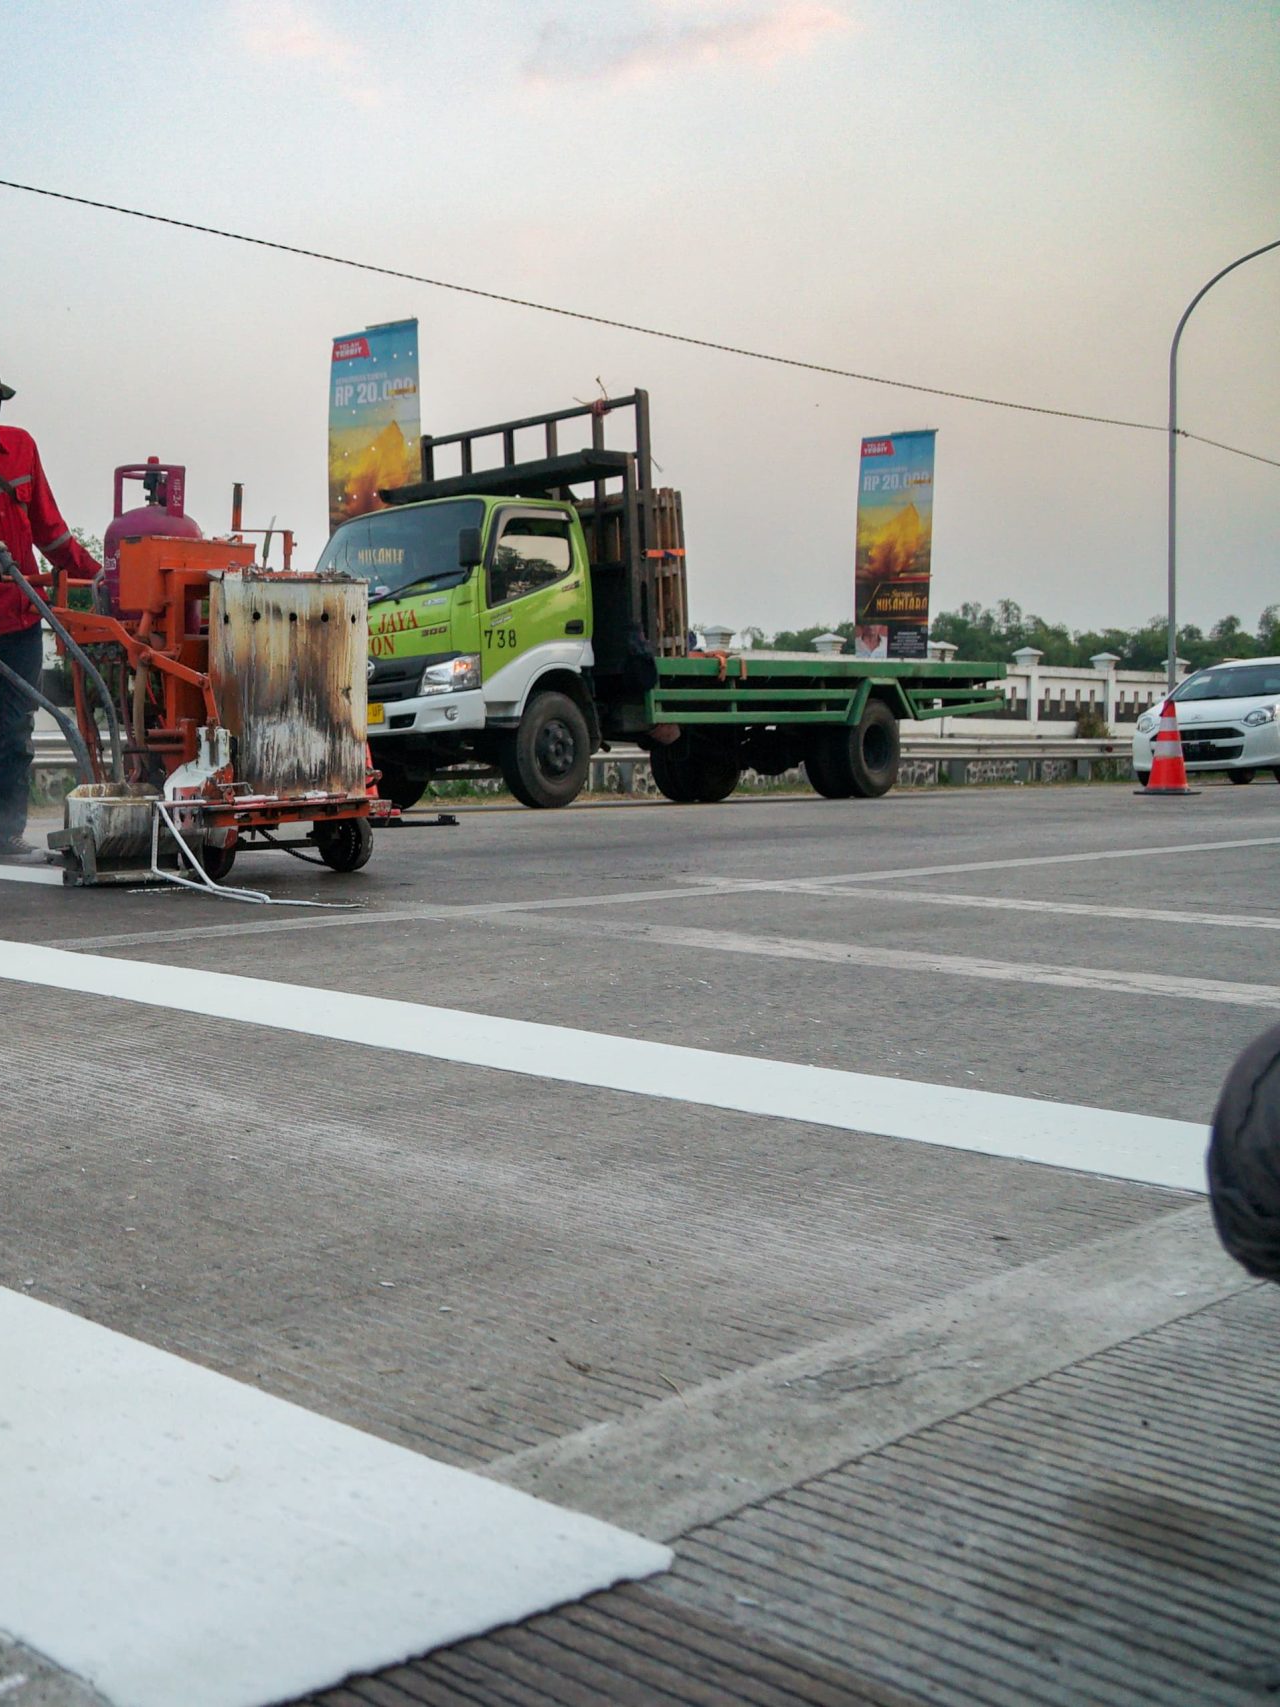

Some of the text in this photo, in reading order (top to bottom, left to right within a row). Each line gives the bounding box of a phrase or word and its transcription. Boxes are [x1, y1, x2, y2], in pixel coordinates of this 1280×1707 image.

[335, 385, 354, 407] RP
[864, 475, 880, 491] RP
[876, 596, 929, 612] NUSANTARA
[378, 609, 420, 634] JAYA
[484, 629, 517, 649] 738
